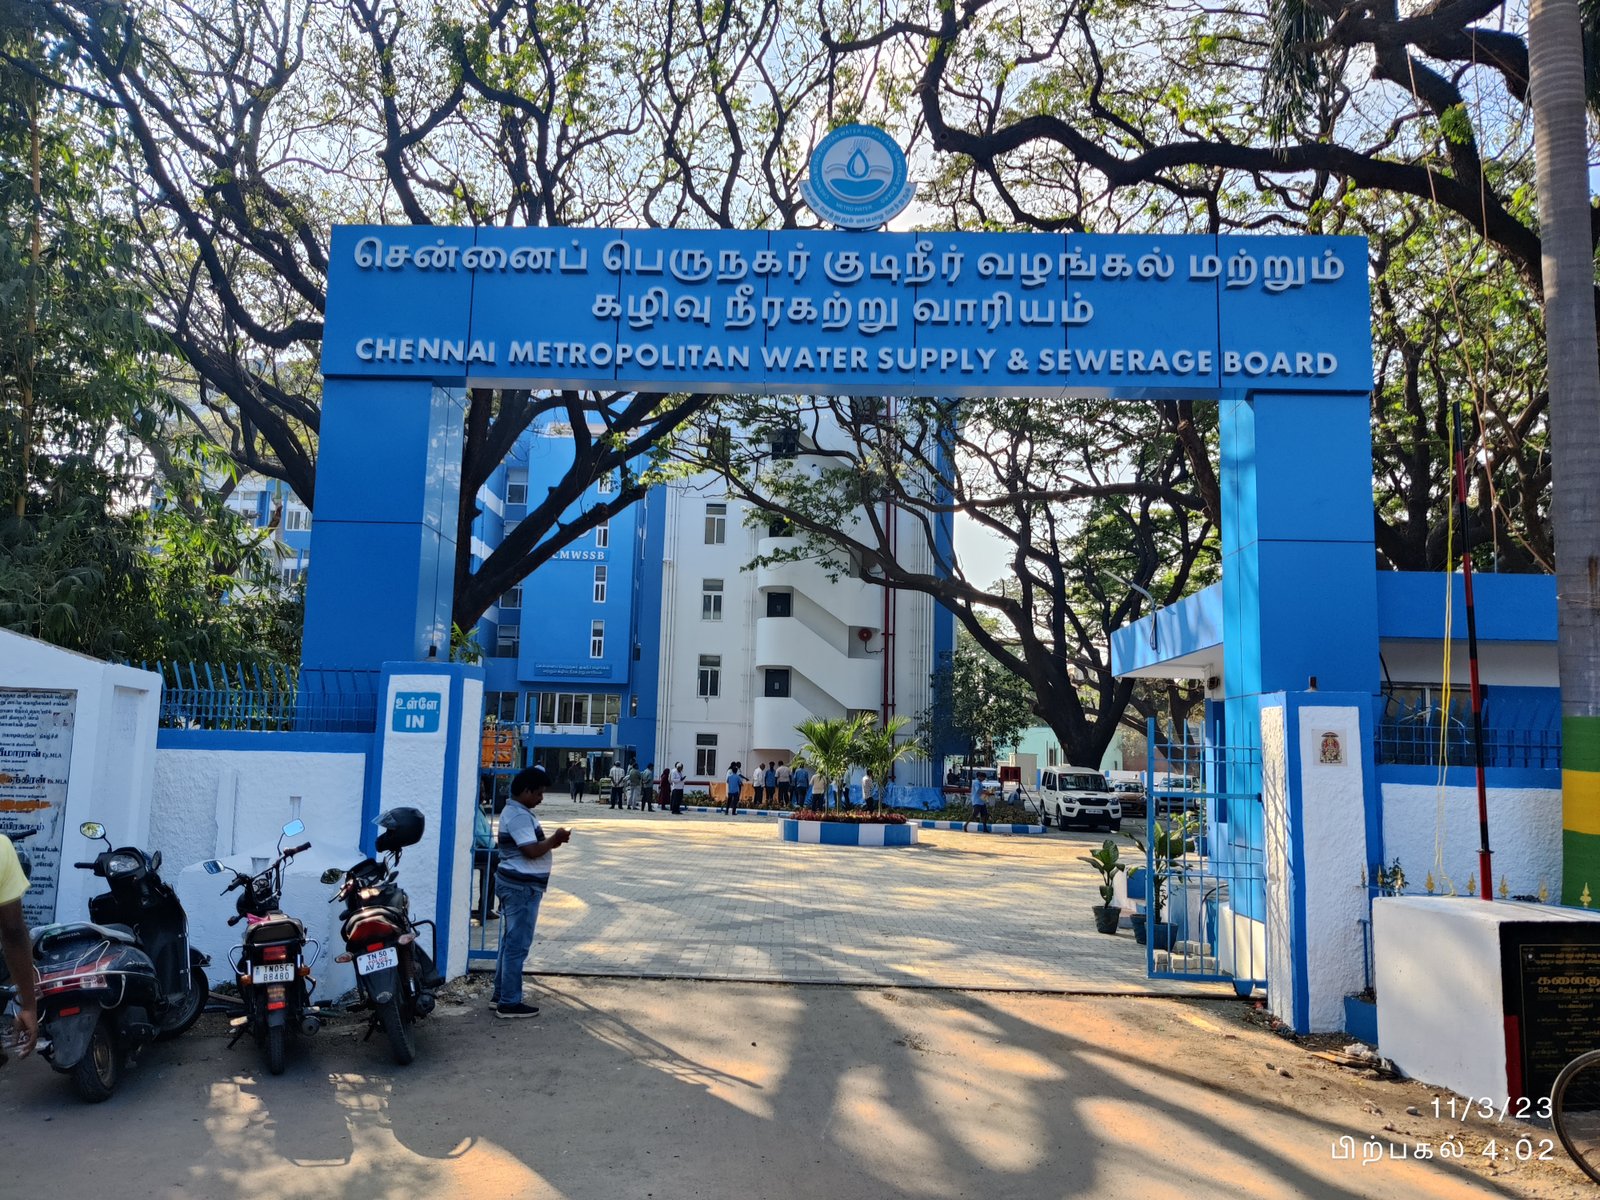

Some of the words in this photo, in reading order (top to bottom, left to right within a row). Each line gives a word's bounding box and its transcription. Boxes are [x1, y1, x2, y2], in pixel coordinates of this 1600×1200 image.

[356, 238, 587, 269] சென்னைப்
[604, 240, 810, 281] பெருநகர்
[825, 240, 964, 282] குடிநீர்
[978, 248, 1175, 285] வழங்கல்
[1191, 249, 1345, 291] மற்றும்
[593, 287, 711, 327] கழிவு
[726, 284, 898, 332] நீரகற்று
[913, 292, 1094, 329] வாரியம்
[356, 338, 496, 364] CHENNAI
[510, 341, 750, 368] METROPOLITAN
[762, 346, 867, 370] WATER
[879, 347, 996, 371] SUPPLY
[1008, 348, 1028, 371] &
[1040, 349, 1211, 373] SEWERAGE
[1224, 350, 1338, 375] BOARD
[395, 697, 438, 710] உள்ளே
[405, 714, 425, 728] IN
[367, 953, 377, 961] TN
[263, 964, 290, 973] TN05C
[365, 963, 375, 972] AV
[376, 959, 393, 969] 2577
